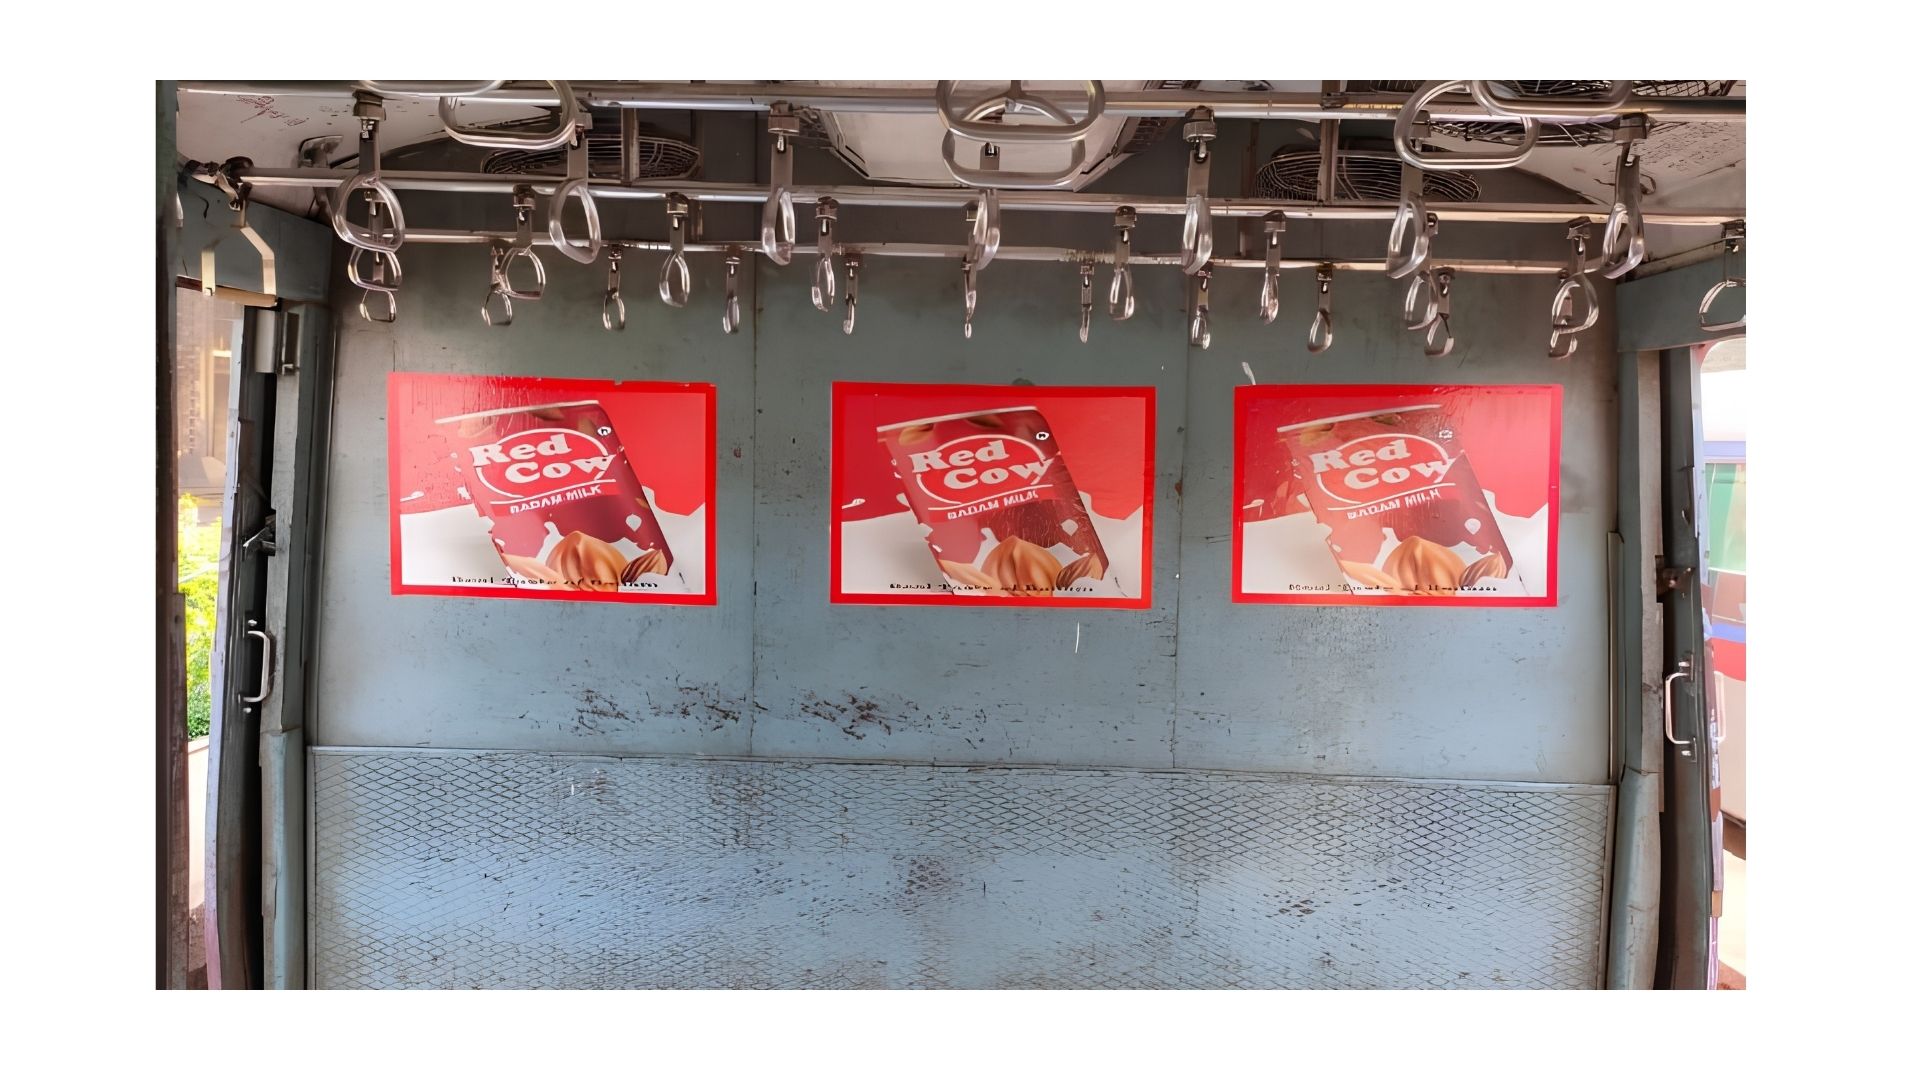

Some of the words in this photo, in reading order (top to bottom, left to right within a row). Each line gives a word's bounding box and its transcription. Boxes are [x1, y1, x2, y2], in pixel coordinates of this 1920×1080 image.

[469, 434, 572, 467] Red
[910, 440, 1009, 474] Red
[1308, 439, 1411, 474] Red
[505, 454, 616, 483] Cow
[943, 458, 1055, 489] Cow
[1343, 456, 1456, 490] Cow
